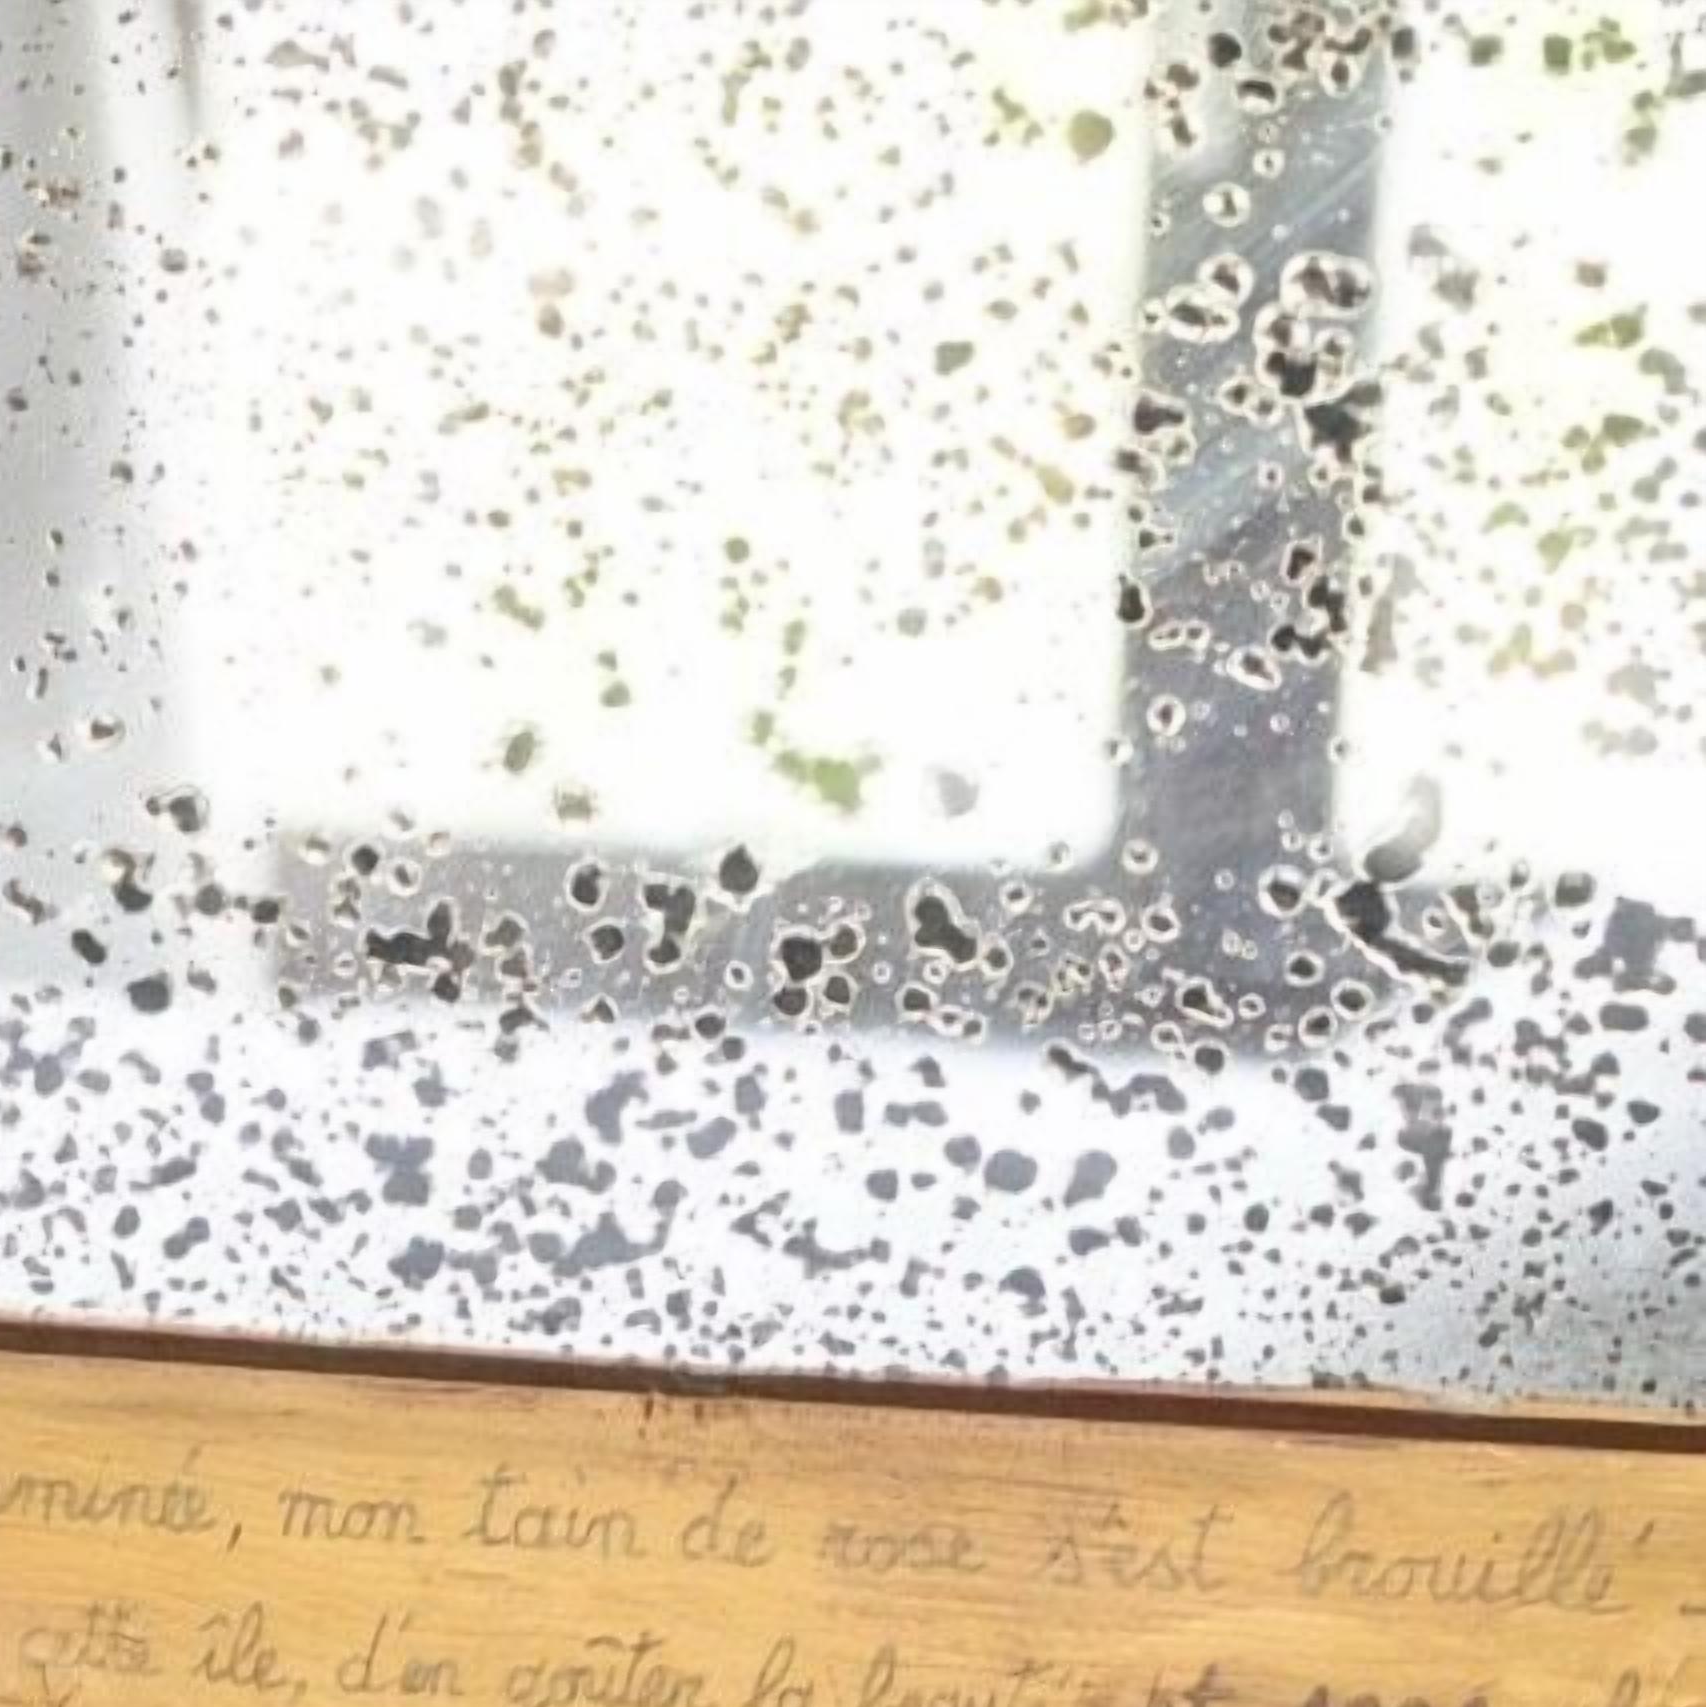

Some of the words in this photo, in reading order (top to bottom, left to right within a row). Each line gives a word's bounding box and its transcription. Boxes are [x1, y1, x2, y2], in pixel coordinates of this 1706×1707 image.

[278, 1488, 430, 1546] mon
[461, 1463, 648, 1558] tain
[681, 1476, 778, 1569] de
[818, 1516, 989, 1575] rose
